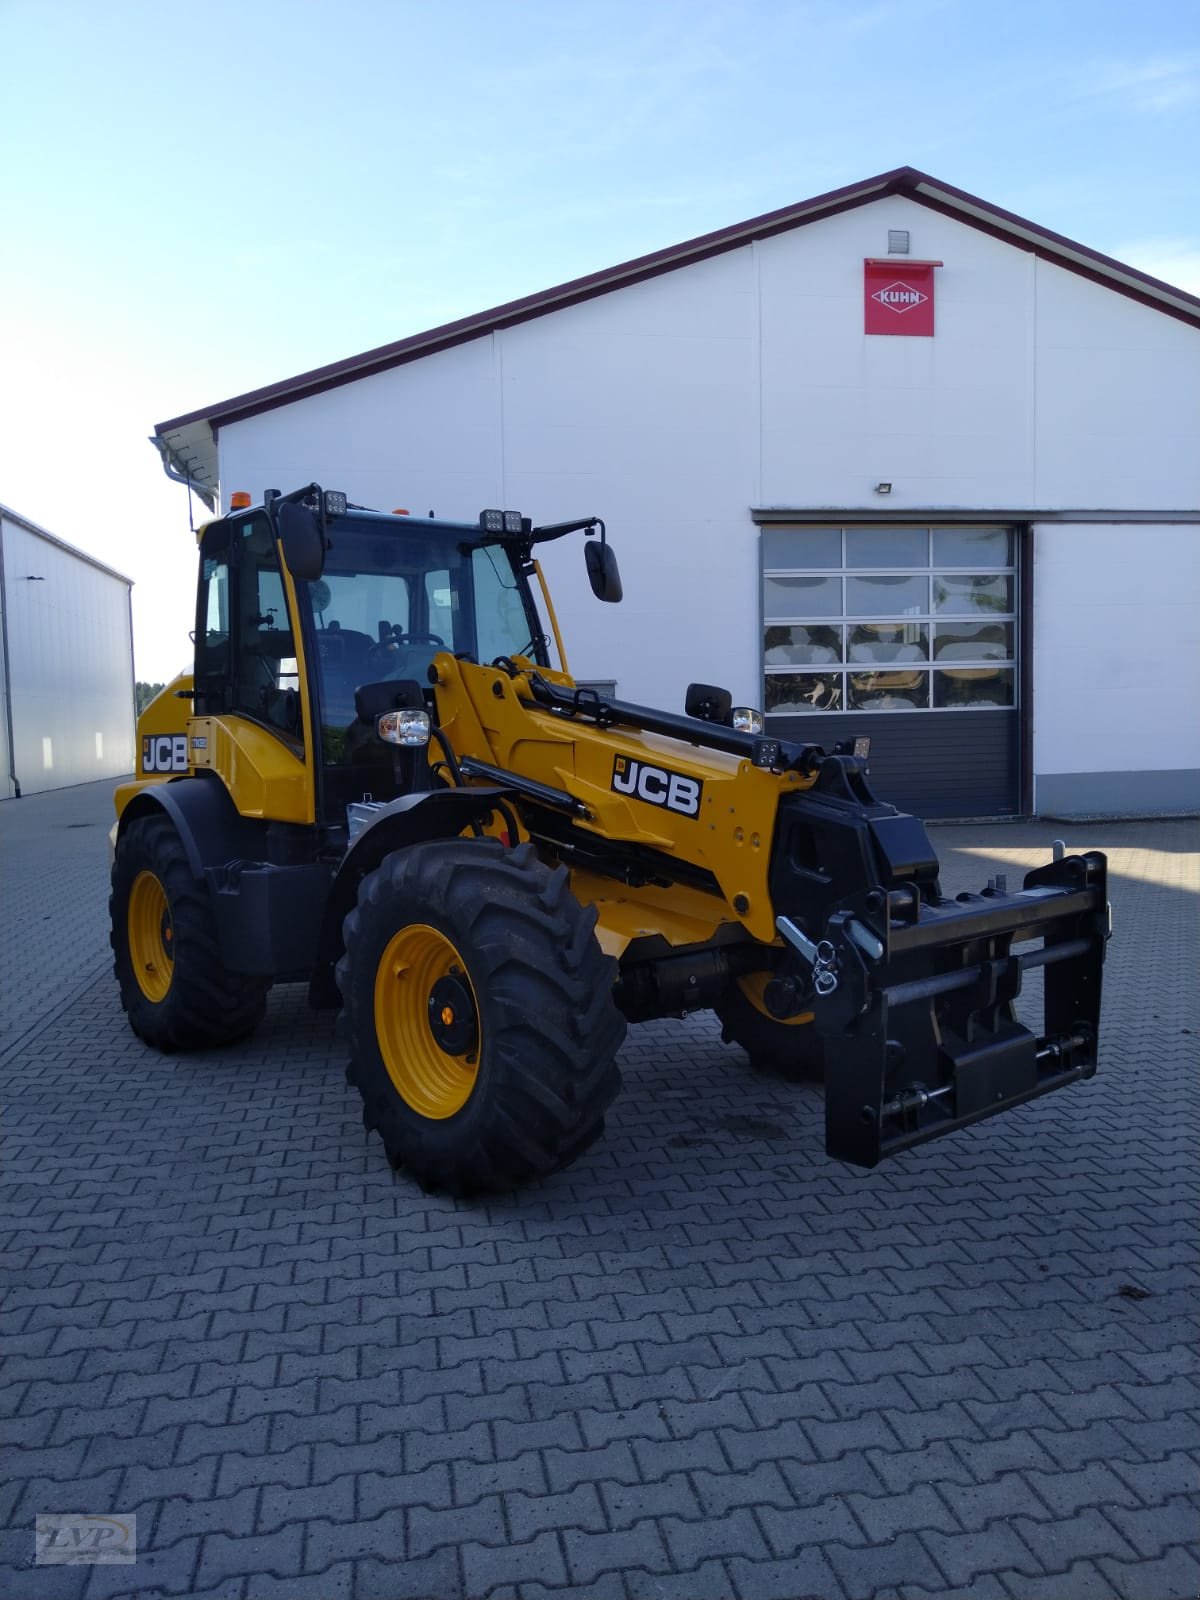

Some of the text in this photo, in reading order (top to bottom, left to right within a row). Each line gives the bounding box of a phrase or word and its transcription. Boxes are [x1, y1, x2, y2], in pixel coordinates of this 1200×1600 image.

[880, 291, 920, 304] KUHN
[143, 737, 188, 771] JCB
[613, 762, 700, 815] JCB
